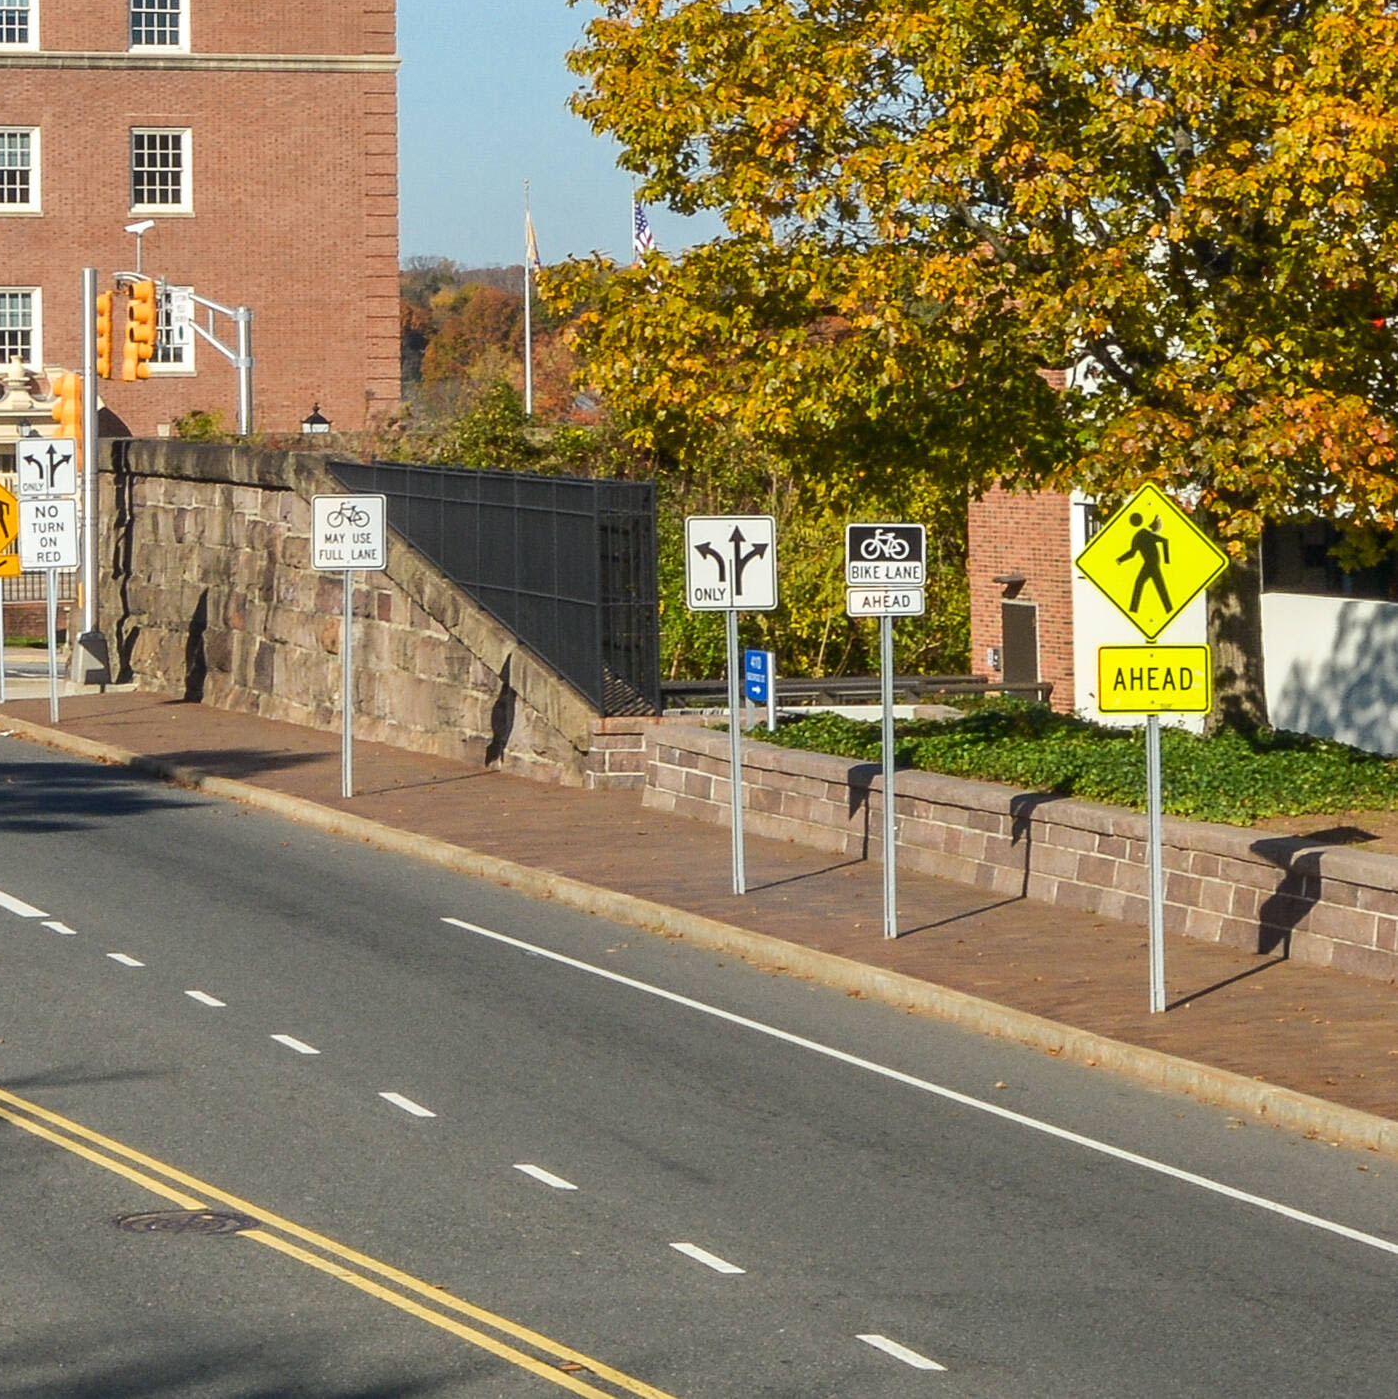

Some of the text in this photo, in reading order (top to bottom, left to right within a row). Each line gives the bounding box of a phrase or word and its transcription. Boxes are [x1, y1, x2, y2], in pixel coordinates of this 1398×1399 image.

[22, 482, 45, 492] ONLY
[35, 505, 58, 518] NO
[31, 522, 64, 533] TURN
[40, 537, 57, 547] ON
[324, 533, 372, 544] MAY USE
[37, 551, 61, 562] RED
[319, 549, 377, 560] FULL LANE
[851, 566, 920, 579] BIKE LANE
[694, 588, 726, 601] ONLY
[862, 595, 911, 608] AHEAD
[1113, 667, 1193, 691] AHEAD
